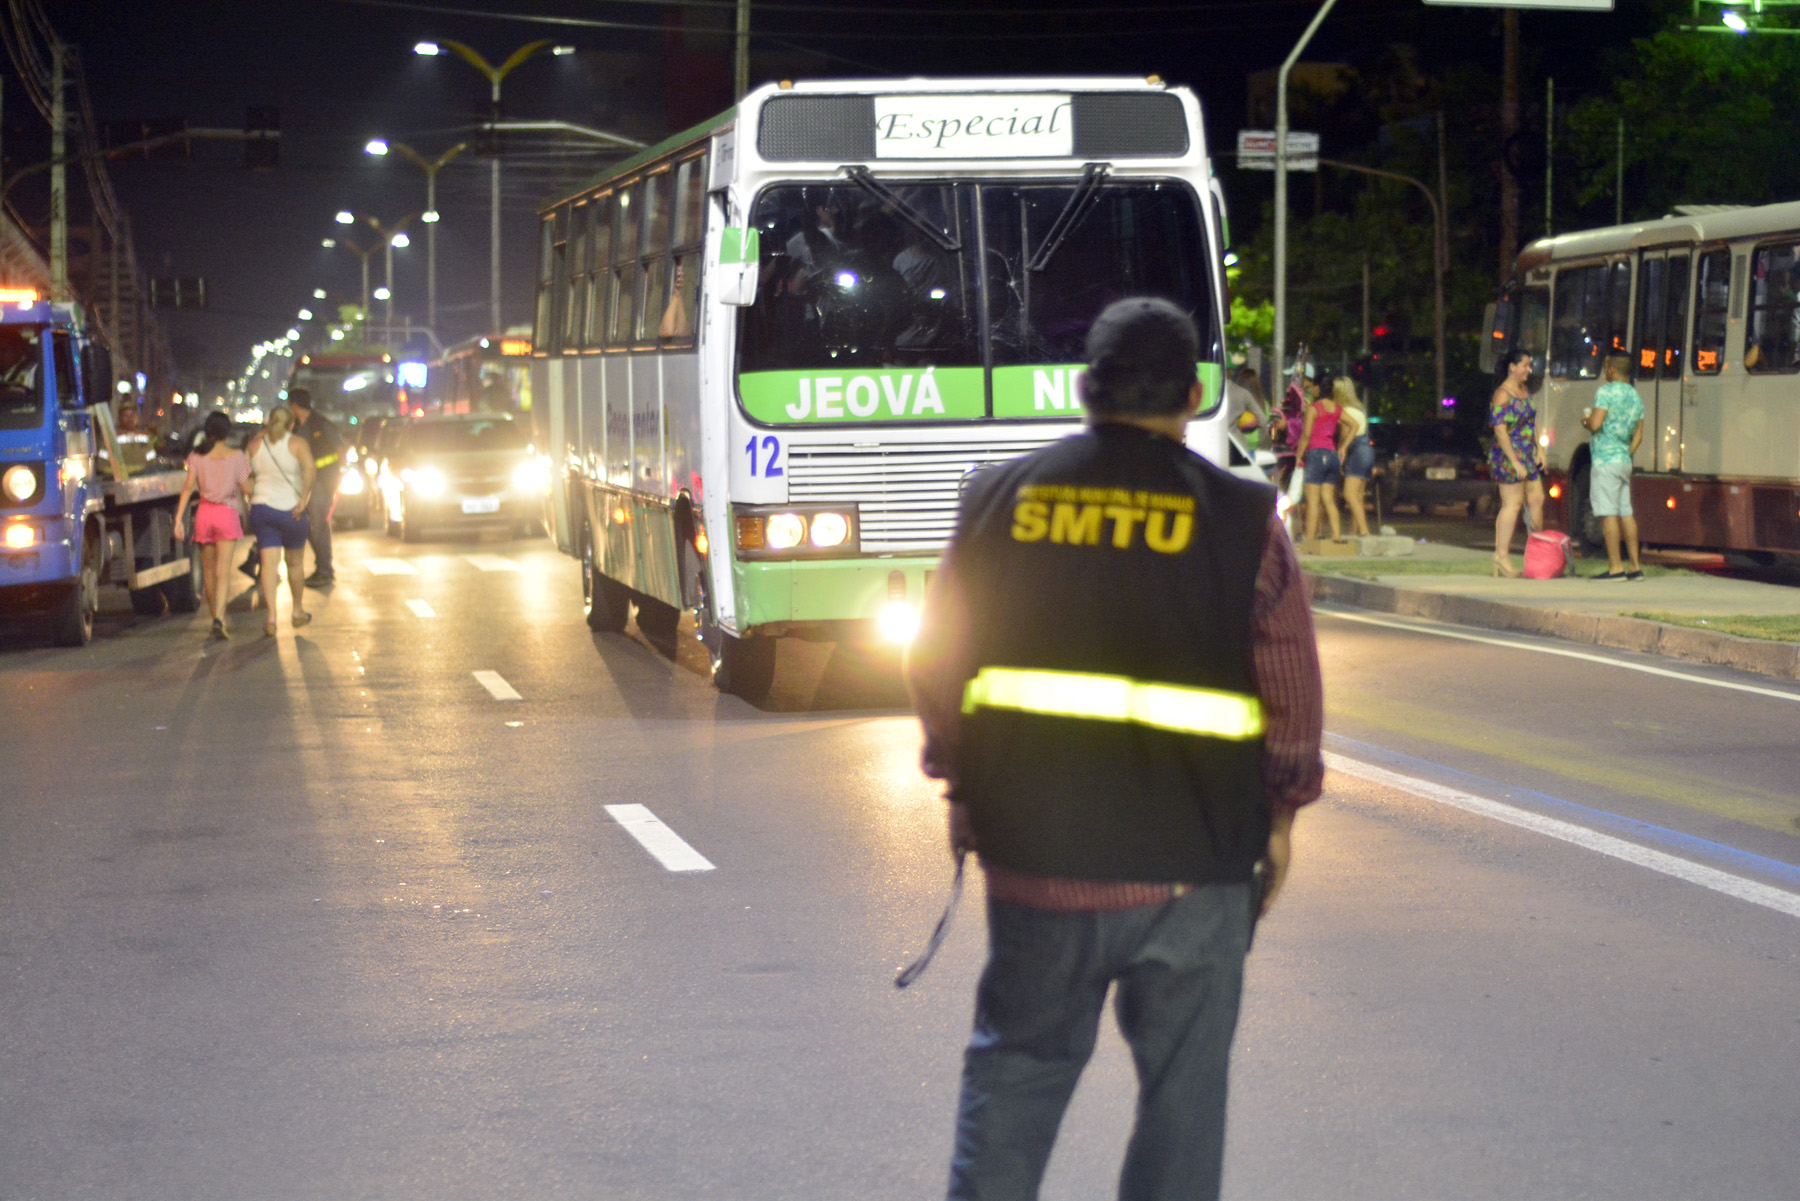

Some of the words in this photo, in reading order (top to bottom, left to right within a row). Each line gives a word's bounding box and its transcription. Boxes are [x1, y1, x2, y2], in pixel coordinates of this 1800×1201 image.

[876, 102, 1072, 149] Especial
[785, 366, 946, 420] JEOVÁ
[1033, 369, 1081, 410] NI
[745, 435, 784, 479] 12
[1010, 501, 1193, 554] SMTU
